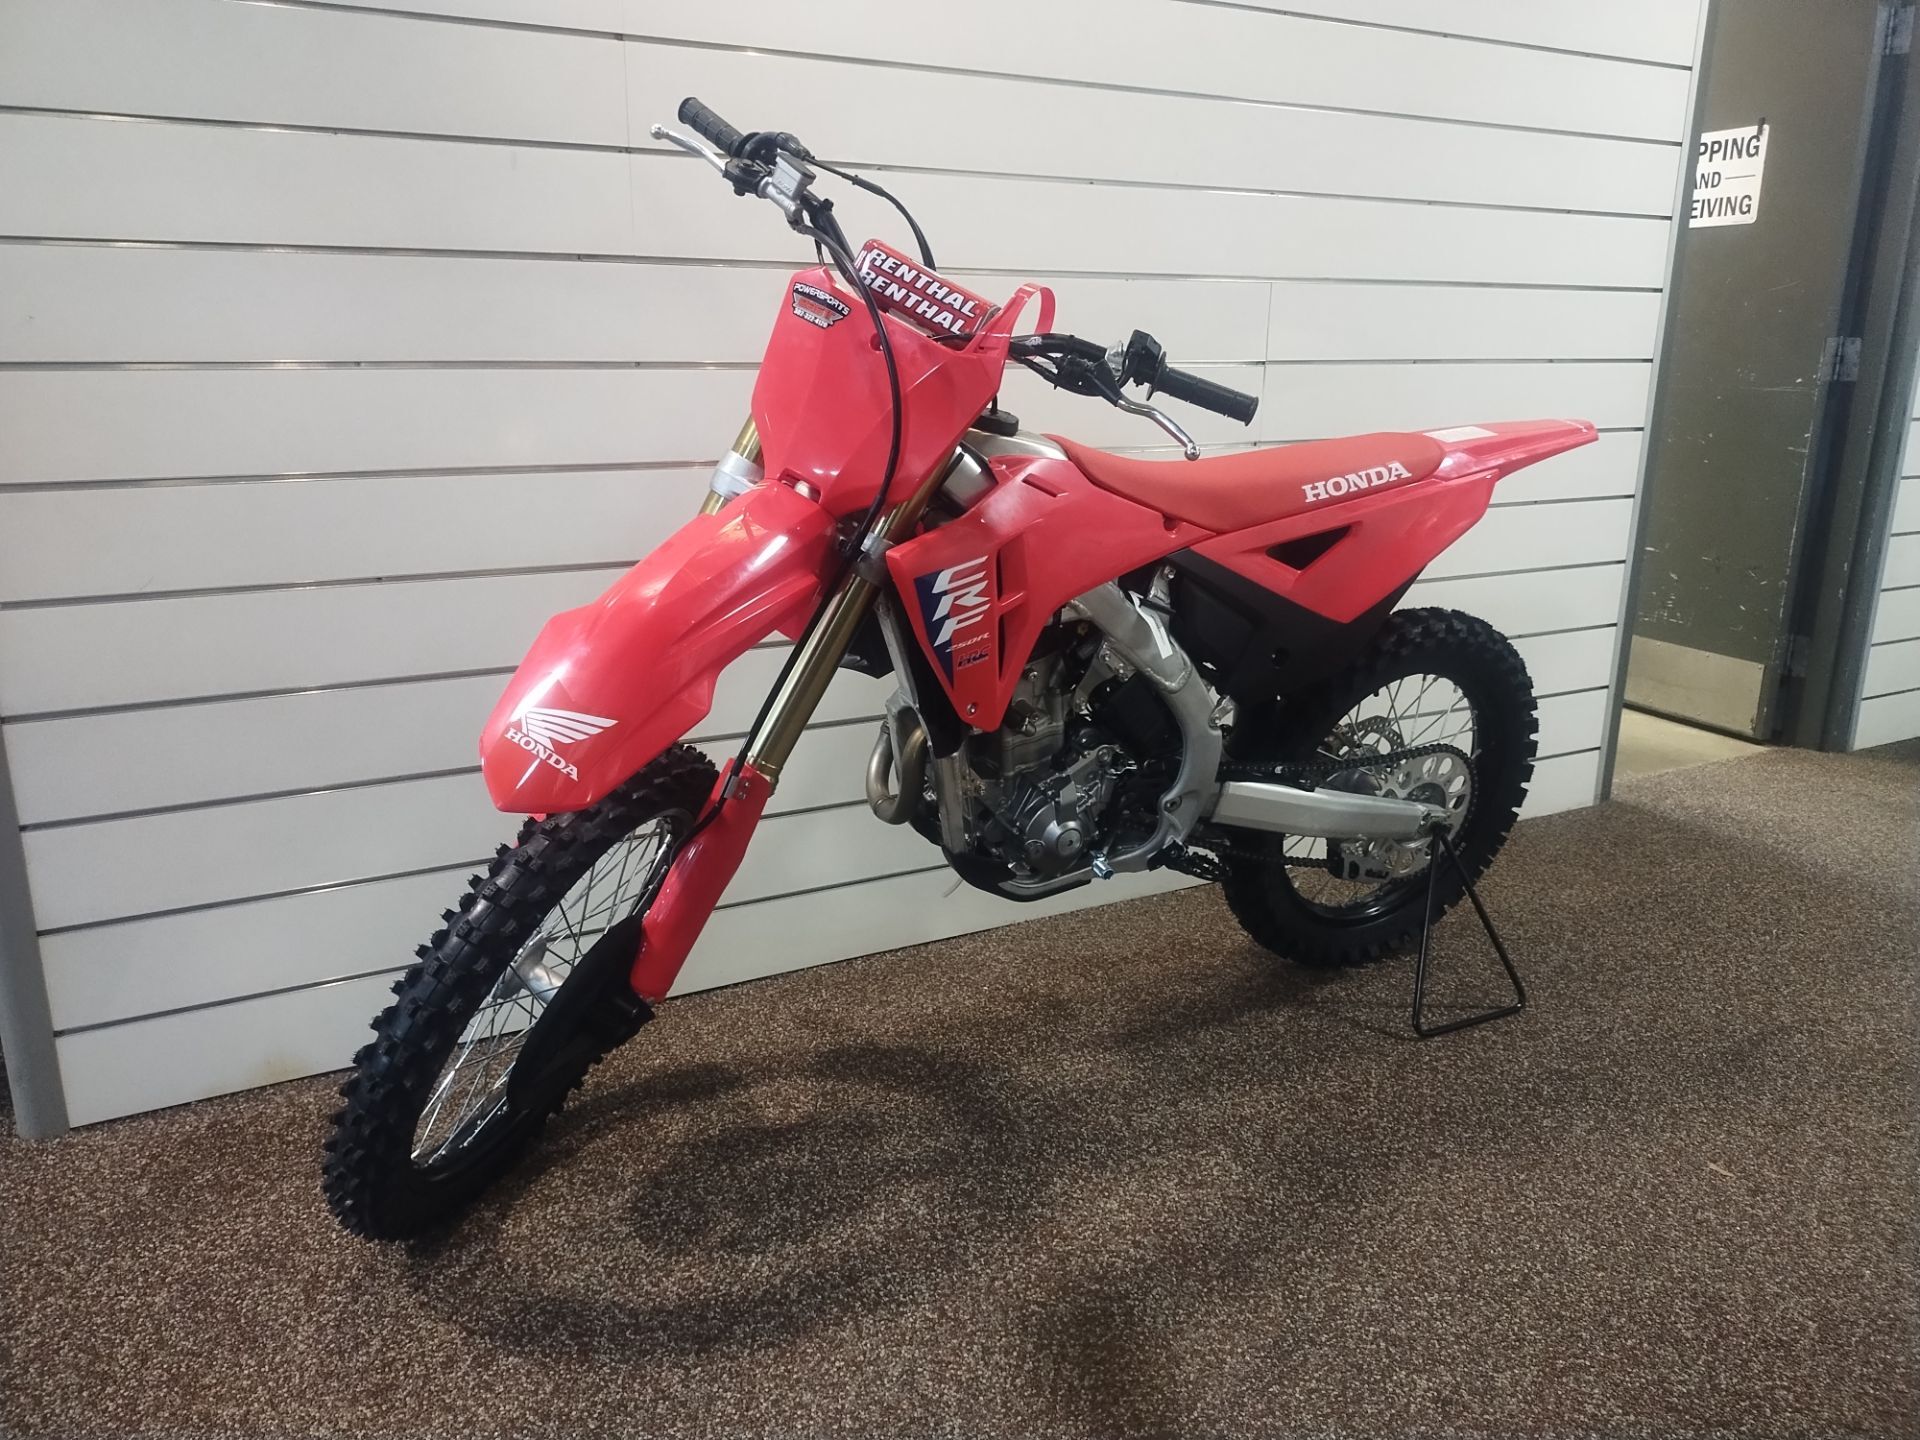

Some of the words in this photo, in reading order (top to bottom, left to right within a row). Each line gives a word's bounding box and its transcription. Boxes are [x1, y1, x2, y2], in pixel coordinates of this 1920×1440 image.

[1695, 171, 1722, 189] ND
[794, 282, 851, 316] POWERSPORTS
[859, 269, 967, 335] RENTHAL
[867, 247, 976, 318] RENTHAL
[1301, 461, 1412, 502] HONDA
[932, 555, 991, 647] CRF
[504, 727, 579, 782] HONDA
